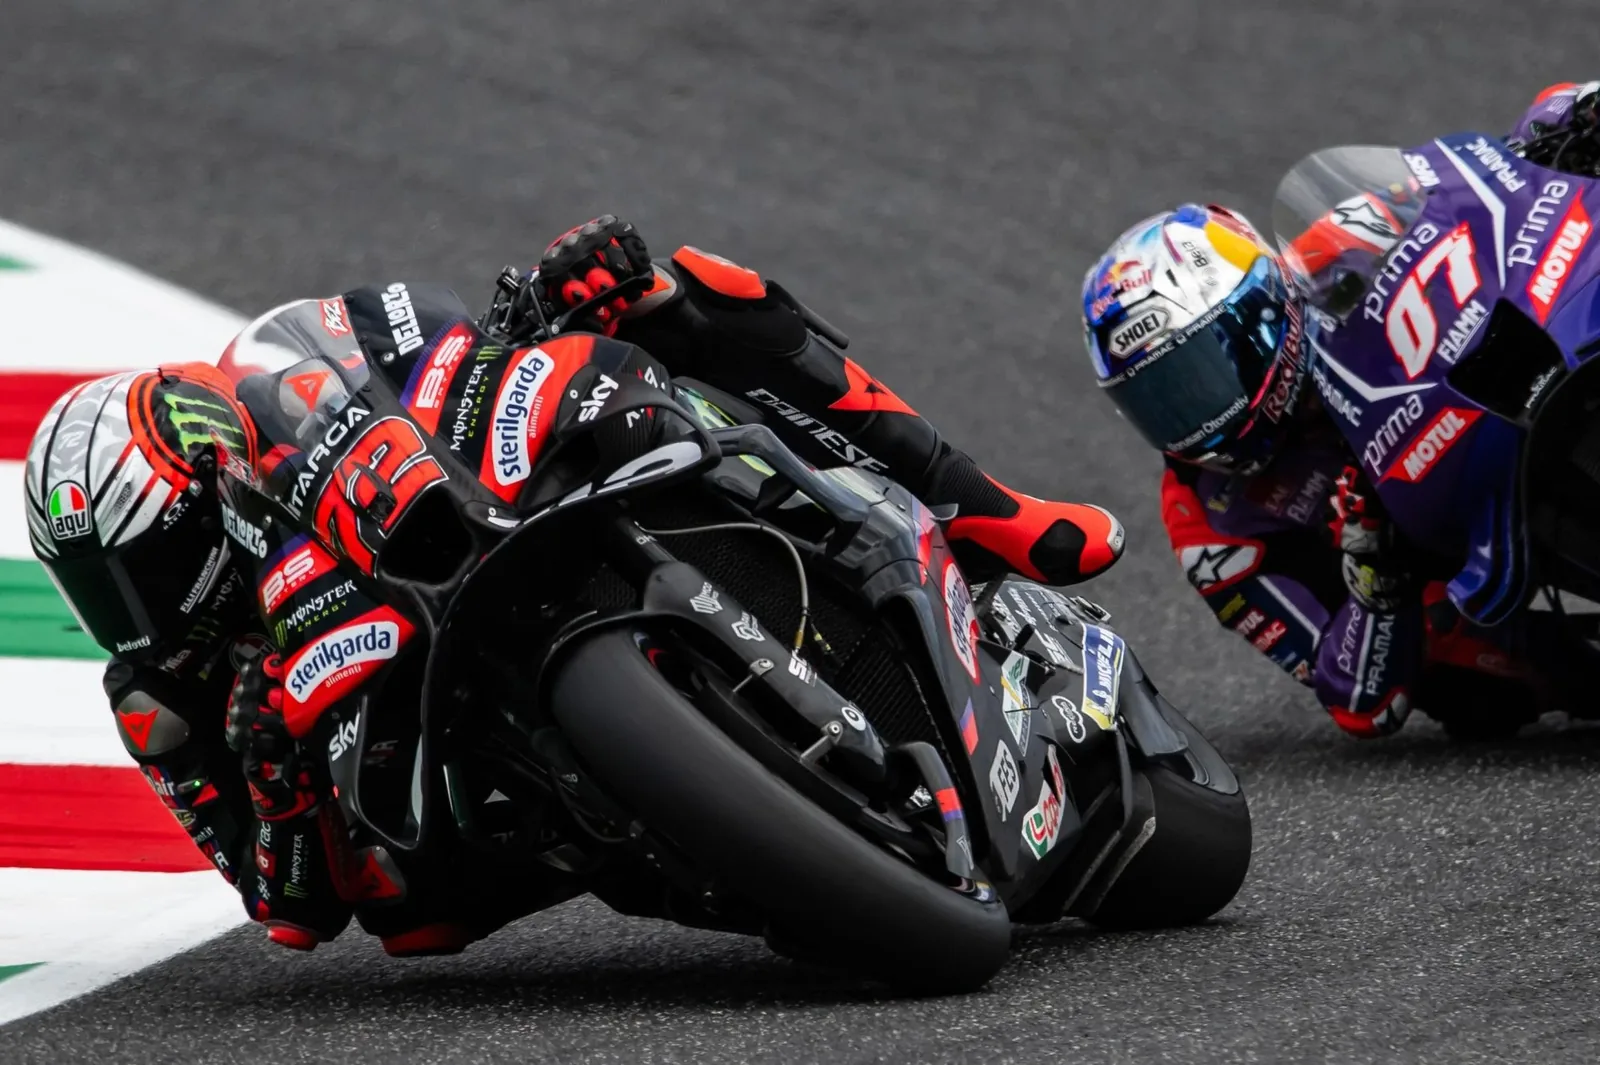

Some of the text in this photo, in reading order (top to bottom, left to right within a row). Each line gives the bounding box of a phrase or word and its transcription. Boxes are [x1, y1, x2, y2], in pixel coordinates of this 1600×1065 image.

[1466, 136, 1527, 193] PRAMAC
[1507, 180, 1570, 268] prima
[1364, 223, 1439, 324] prima
[1531, 219, 1590, 304] MOTUL
[1386, 220, 1482, 381] 07
[1437, 299, 1489, 362] FIAMM
[1115, 313, 1160, 352] SHOEI
[415, 335, 467, 409] BS
[578, 374, 619, 423] sky
[450, 362, 488, 451] MONSTER
[467, 375, 490, 439] ENERGY
[494, 355, 545, 478] sterilgarda
[528, 395, 544, 439] alimenti
[1364, 393, 1424, 477] prima
[1403, 409, 1466, 481] MOTUL
[54, 510, 87, 537] agv
[262, 548, 315, 609] BS
[286, 579, 358, 630] MONSTER
[297, 600, 348, 633] ENERGY
[291, 624, 391, 695] sterilgarda
[324, 663, 362, 688] alimenti
[329, 710, 360, 762] sky
